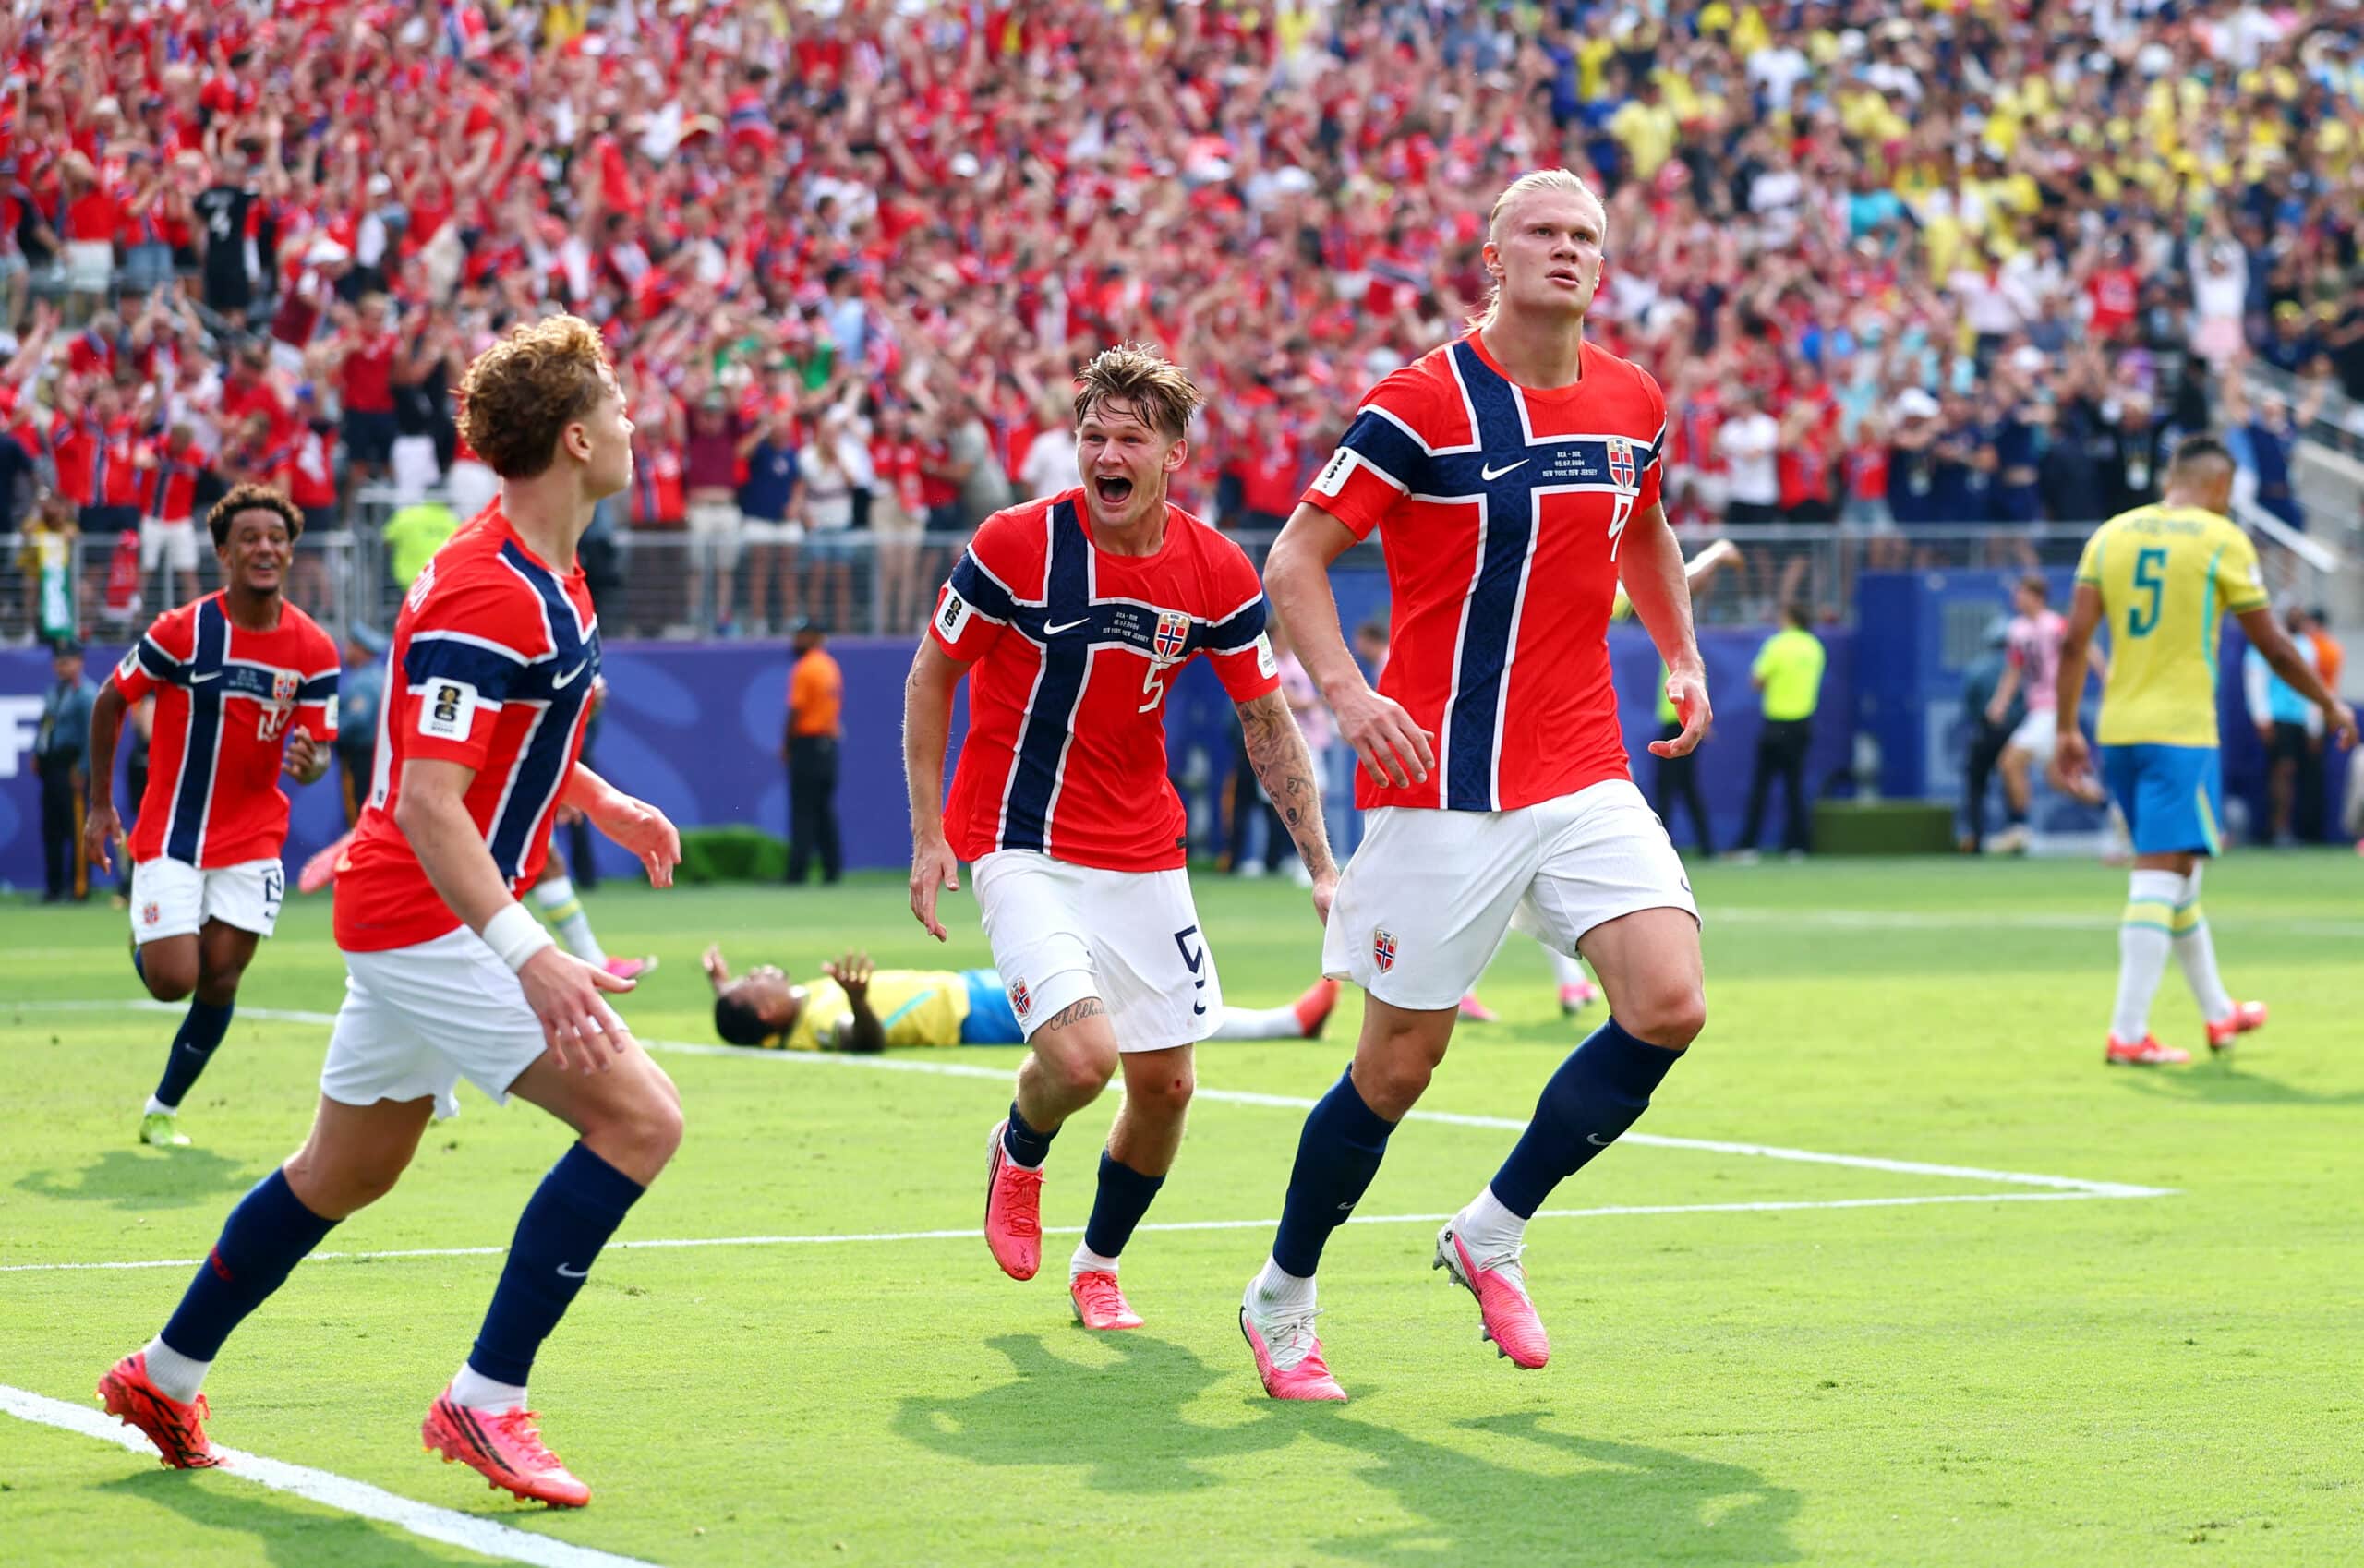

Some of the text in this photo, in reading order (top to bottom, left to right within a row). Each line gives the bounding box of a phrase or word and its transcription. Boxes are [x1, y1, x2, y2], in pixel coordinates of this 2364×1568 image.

[1608, 493, 1634, 562] 9
[2129, 549, 2168, 638] 5
[1138, 661, 1172, 714] 5
[1174, 924, 1206, 989] 5
